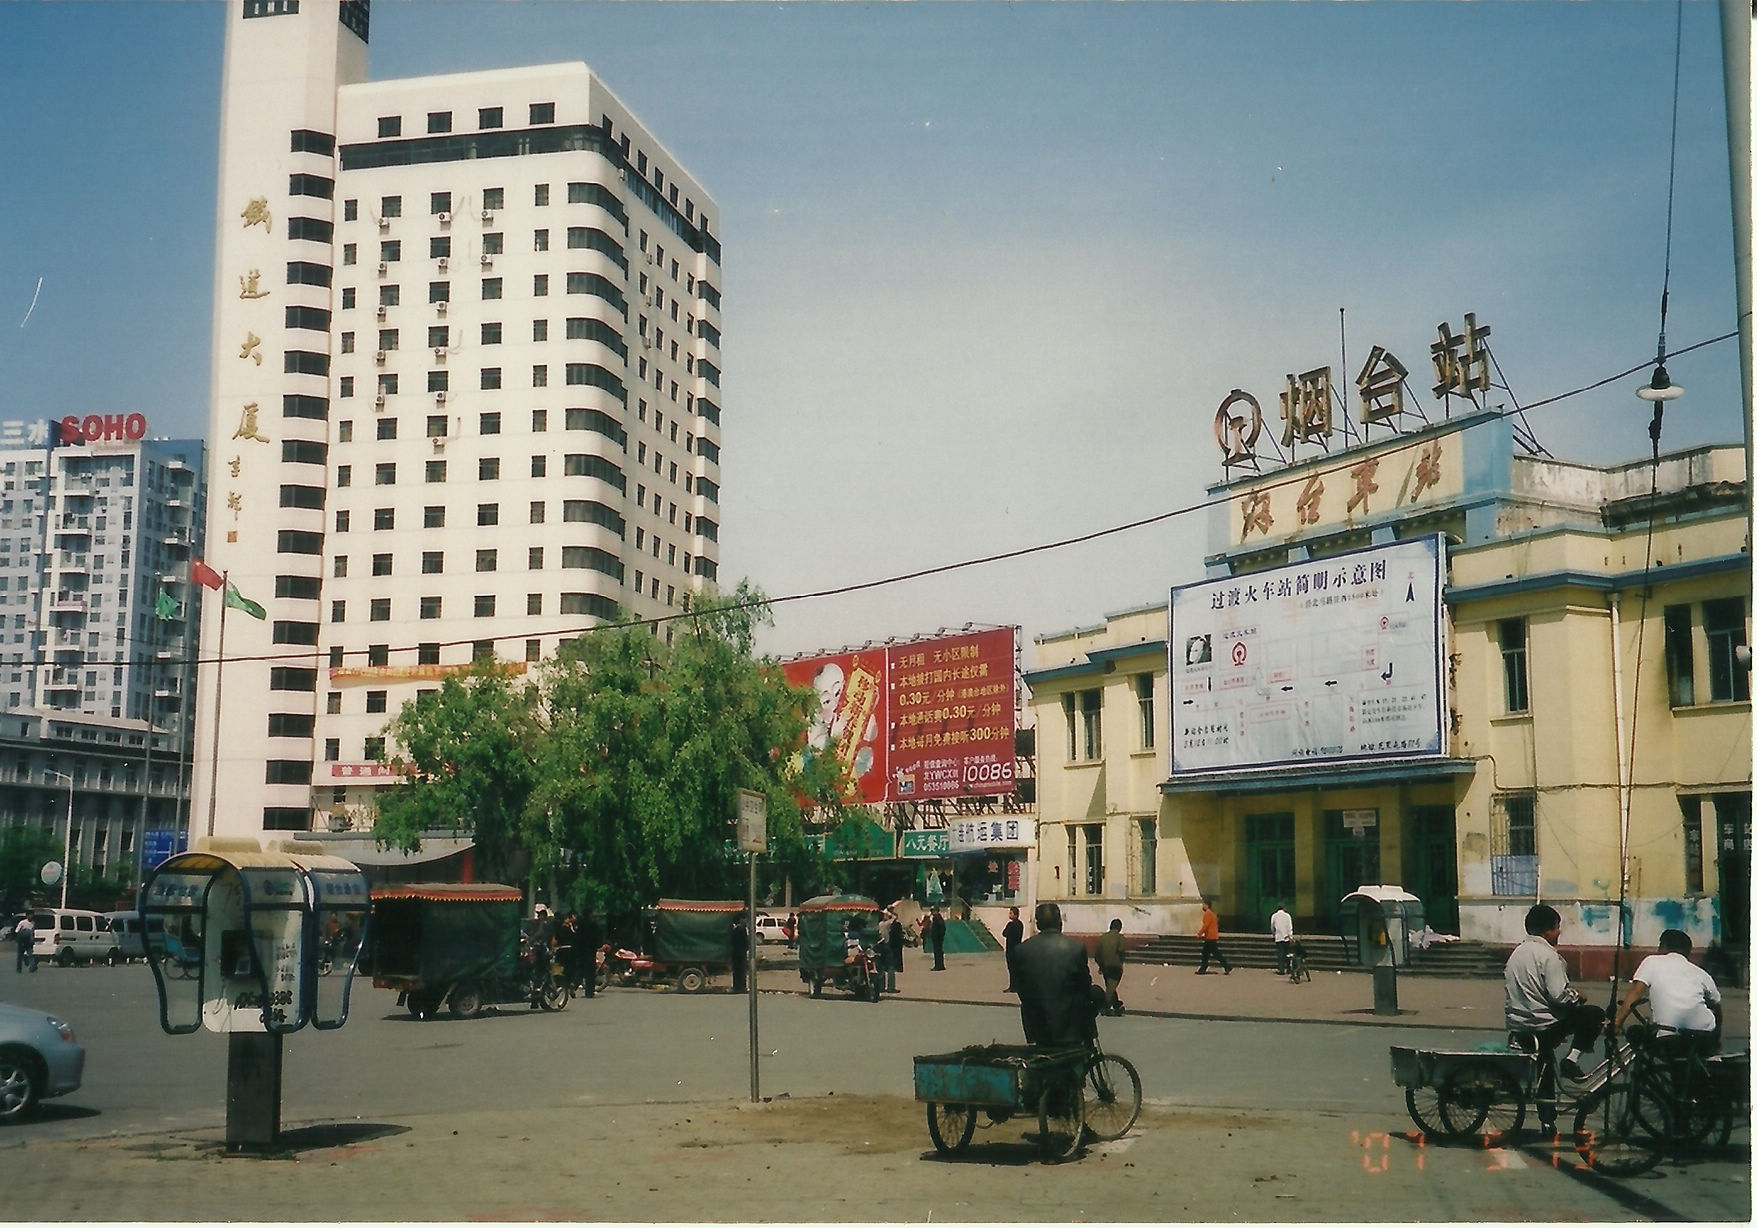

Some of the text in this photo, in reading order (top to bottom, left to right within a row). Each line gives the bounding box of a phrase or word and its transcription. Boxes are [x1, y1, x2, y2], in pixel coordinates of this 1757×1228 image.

[1279, 312, 1491, 448] 烟台站
[61, 412, 147, 442] SOHO
[1211, 559, 1387, 610] 过渡火车站简明示意图
[899, 644, 979, 669] 无月租 无小区限制
[963, 761, 1013, 782] 10086
[906, 834, 949, 853] 八元餐厅
